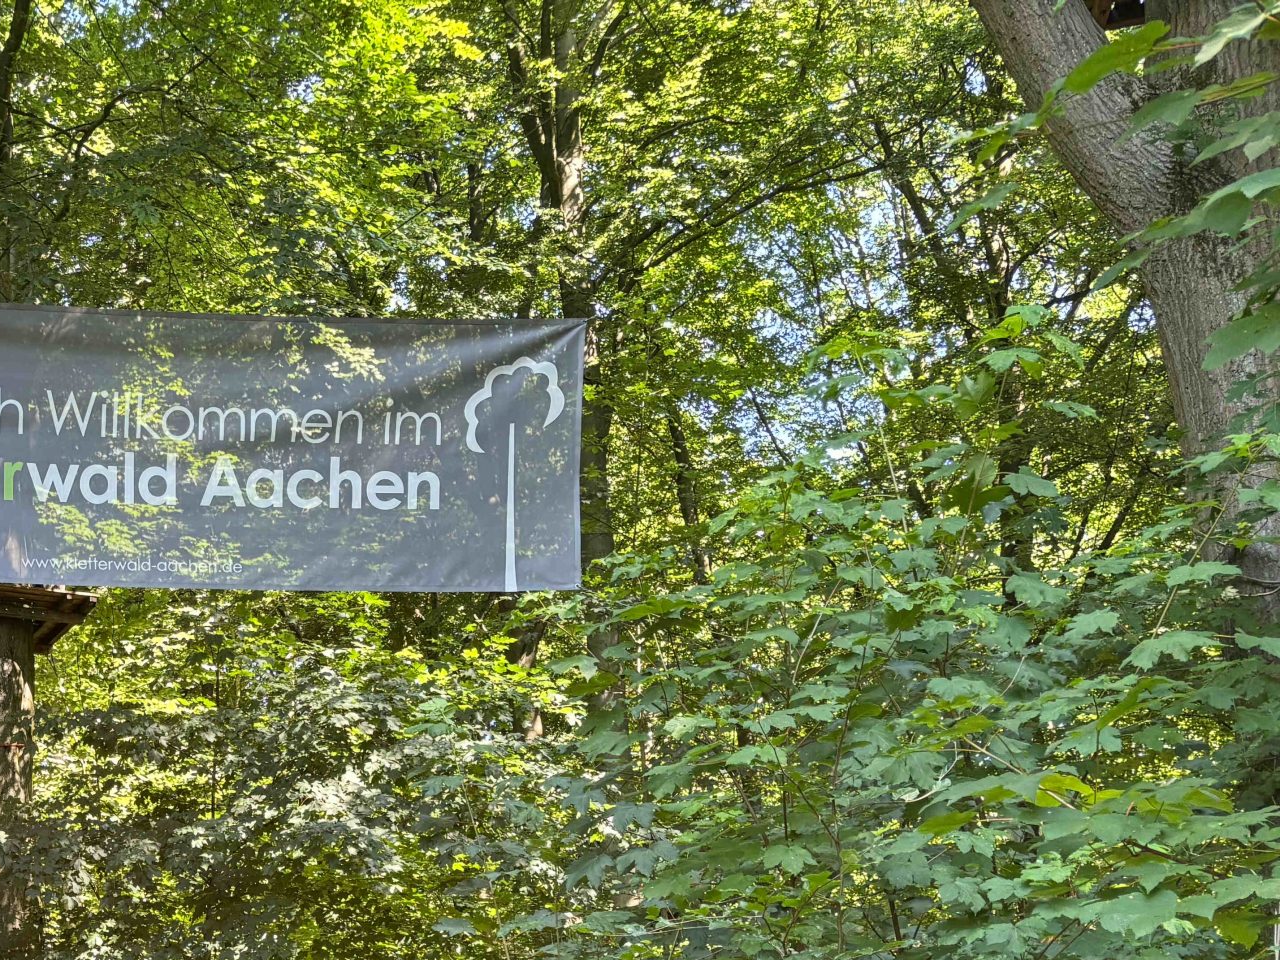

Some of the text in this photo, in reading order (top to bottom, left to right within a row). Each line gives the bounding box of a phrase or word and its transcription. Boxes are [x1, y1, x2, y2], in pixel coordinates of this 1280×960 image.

[46, 389, 363, 444] Willkommen
[383, 398, 442, 446] im
[200, 456, 441, 511] Aachen
[21, 556, 243, 574] www.kletterwald-aachen.de
